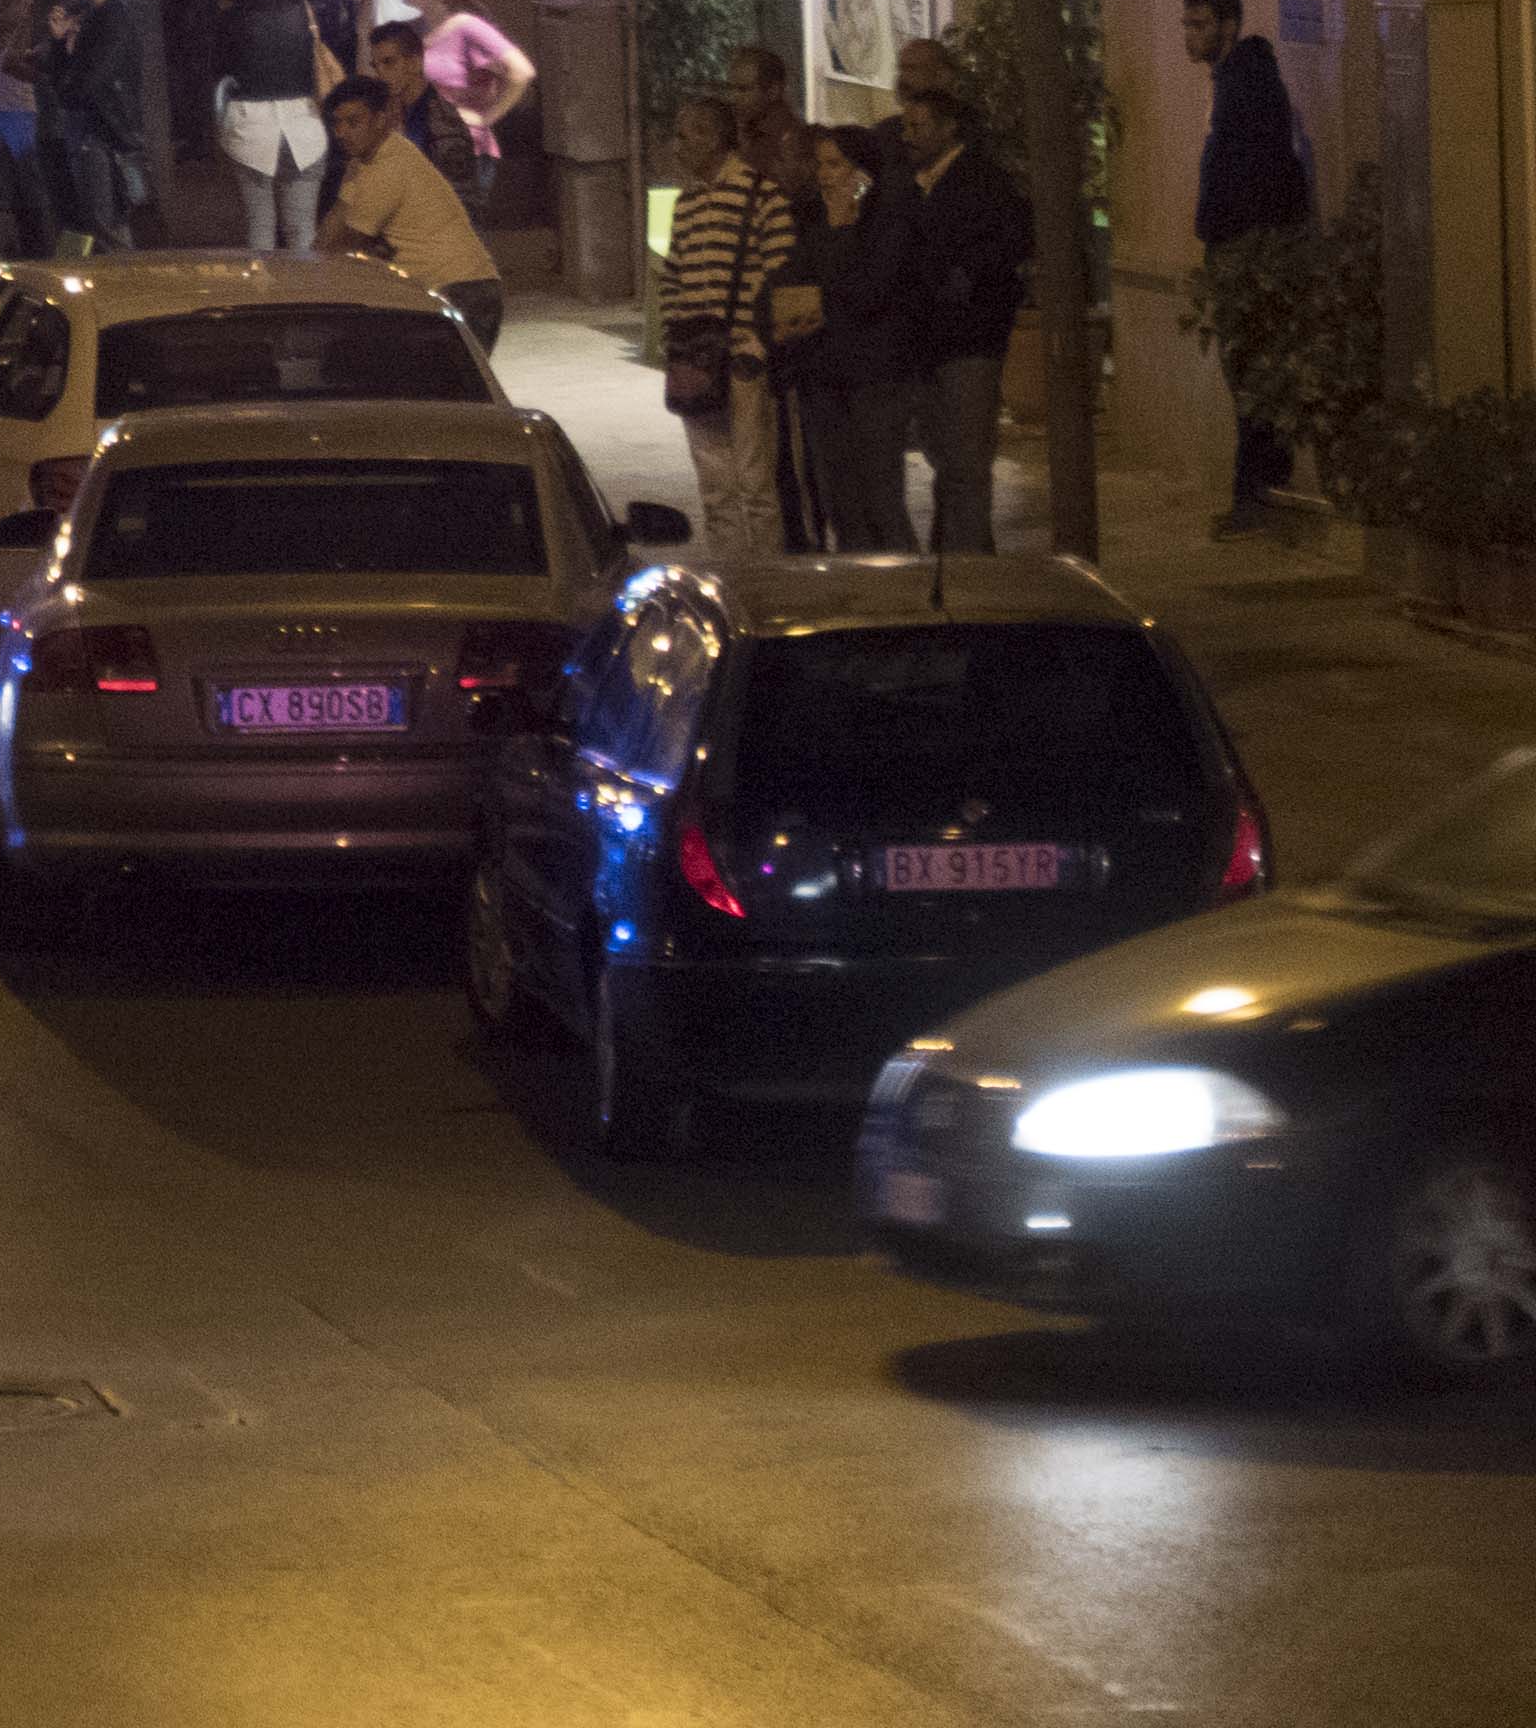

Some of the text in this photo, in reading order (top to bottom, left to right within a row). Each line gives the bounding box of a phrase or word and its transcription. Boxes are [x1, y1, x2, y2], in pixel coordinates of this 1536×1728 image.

[237, 689, 385, 723] CX 890SB
[893, 848, 1056, 885] BX 915YR
